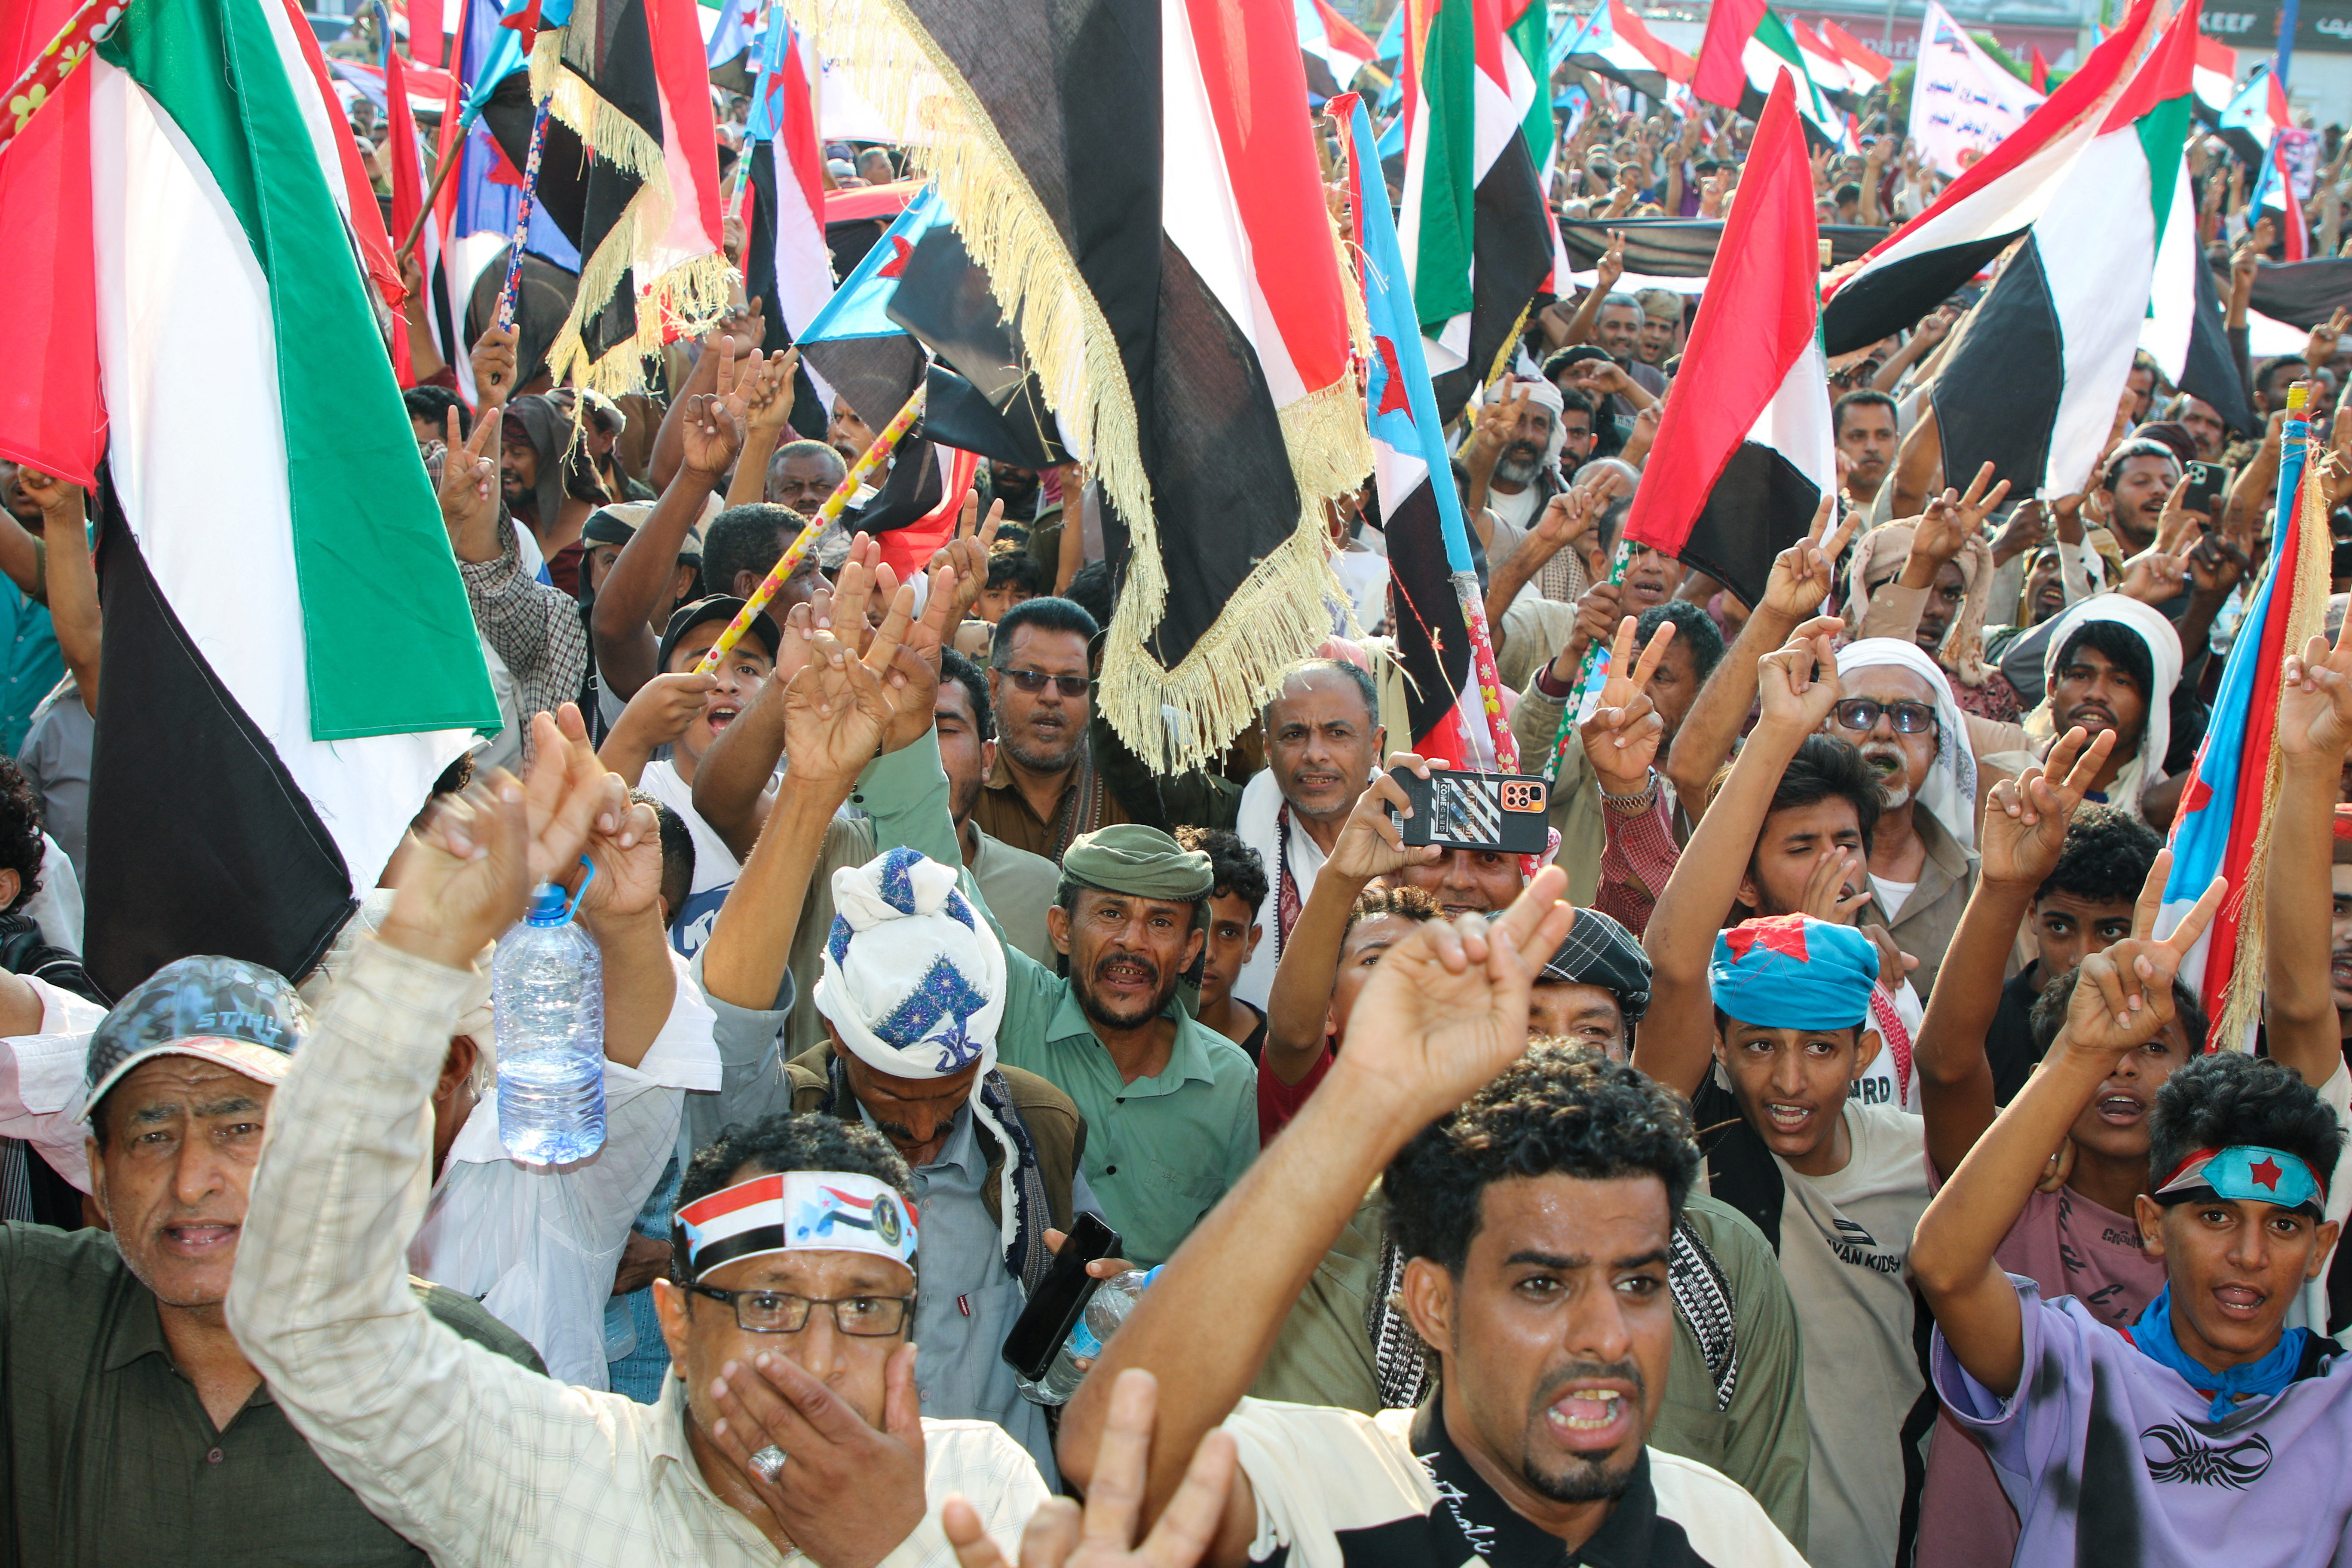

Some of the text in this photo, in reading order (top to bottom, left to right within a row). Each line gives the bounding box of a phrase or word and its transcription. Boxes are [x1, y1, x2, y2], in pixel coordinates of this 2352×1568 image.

[196, 1011, 283, 1035] STIHL
[1827, 1239, 1896, 1273] VAN KIDS
